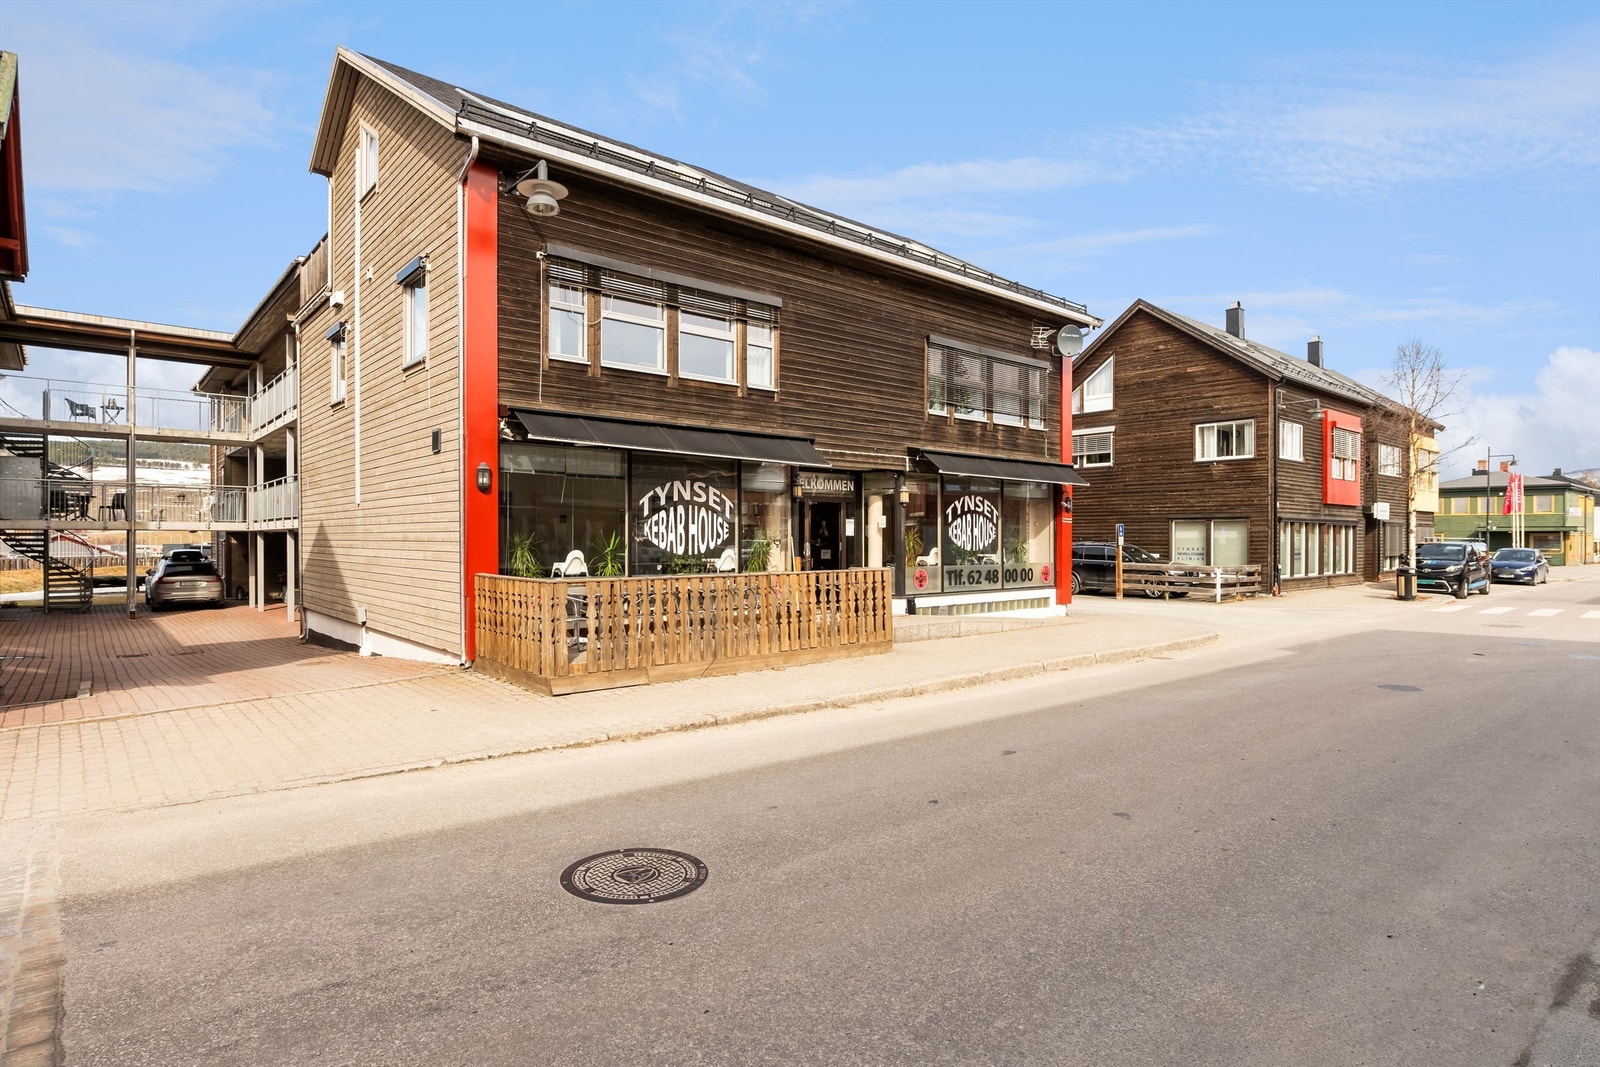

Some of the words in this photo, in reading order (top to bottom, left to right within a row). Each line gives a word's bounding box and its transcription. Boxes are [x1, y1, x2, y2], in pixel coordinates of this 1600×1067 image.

[639, 480, 734, 519] TYNSET
[798, 477, 855, 491] ELKOMMEN
[945, 495, 999, 524] TYNSET
[643, 504, 686, 556] KEBAB
[688, 504, 730, 556] HOUSE
[948, 513, 972, 552] KEBAB
[972, 513, 997, 552] HOUSE
[946, 569, 966, 586] Tlf.
[967, 569, 983, 585] 62
[984, 569, 1000, 584] 48
[1004, 568, 1018, 583] 00
[1020, 567, 1034, 582] 00
